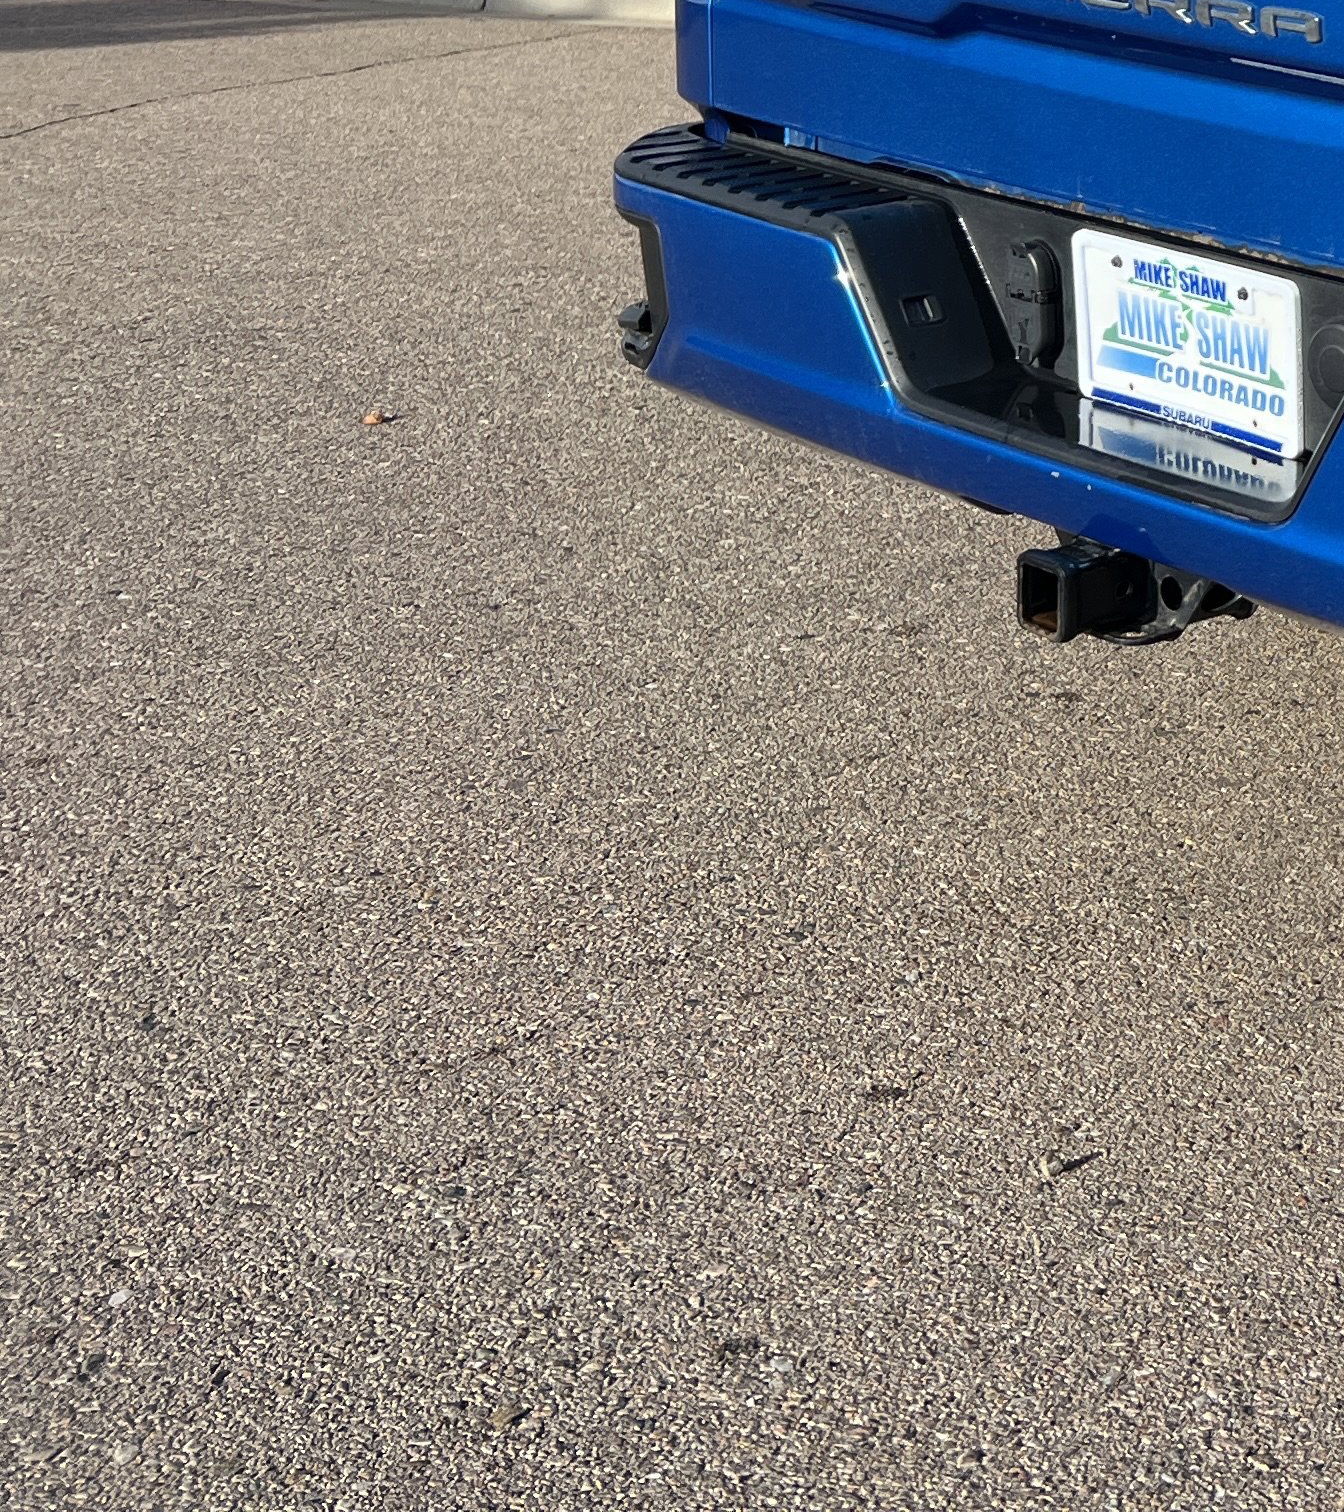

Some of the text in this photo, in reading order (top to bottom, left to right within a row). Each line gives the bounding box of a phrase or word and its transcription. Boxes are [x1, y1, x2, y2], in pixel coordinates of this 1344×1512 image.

[1133, 258, 1227, 302] MIKE SHAW
[1118, 291, 1270, 374] MIKE SHAW
[1158, 362, 1285, 417] COLORADO
[1162, 406, 1210, 429] SUBARU
